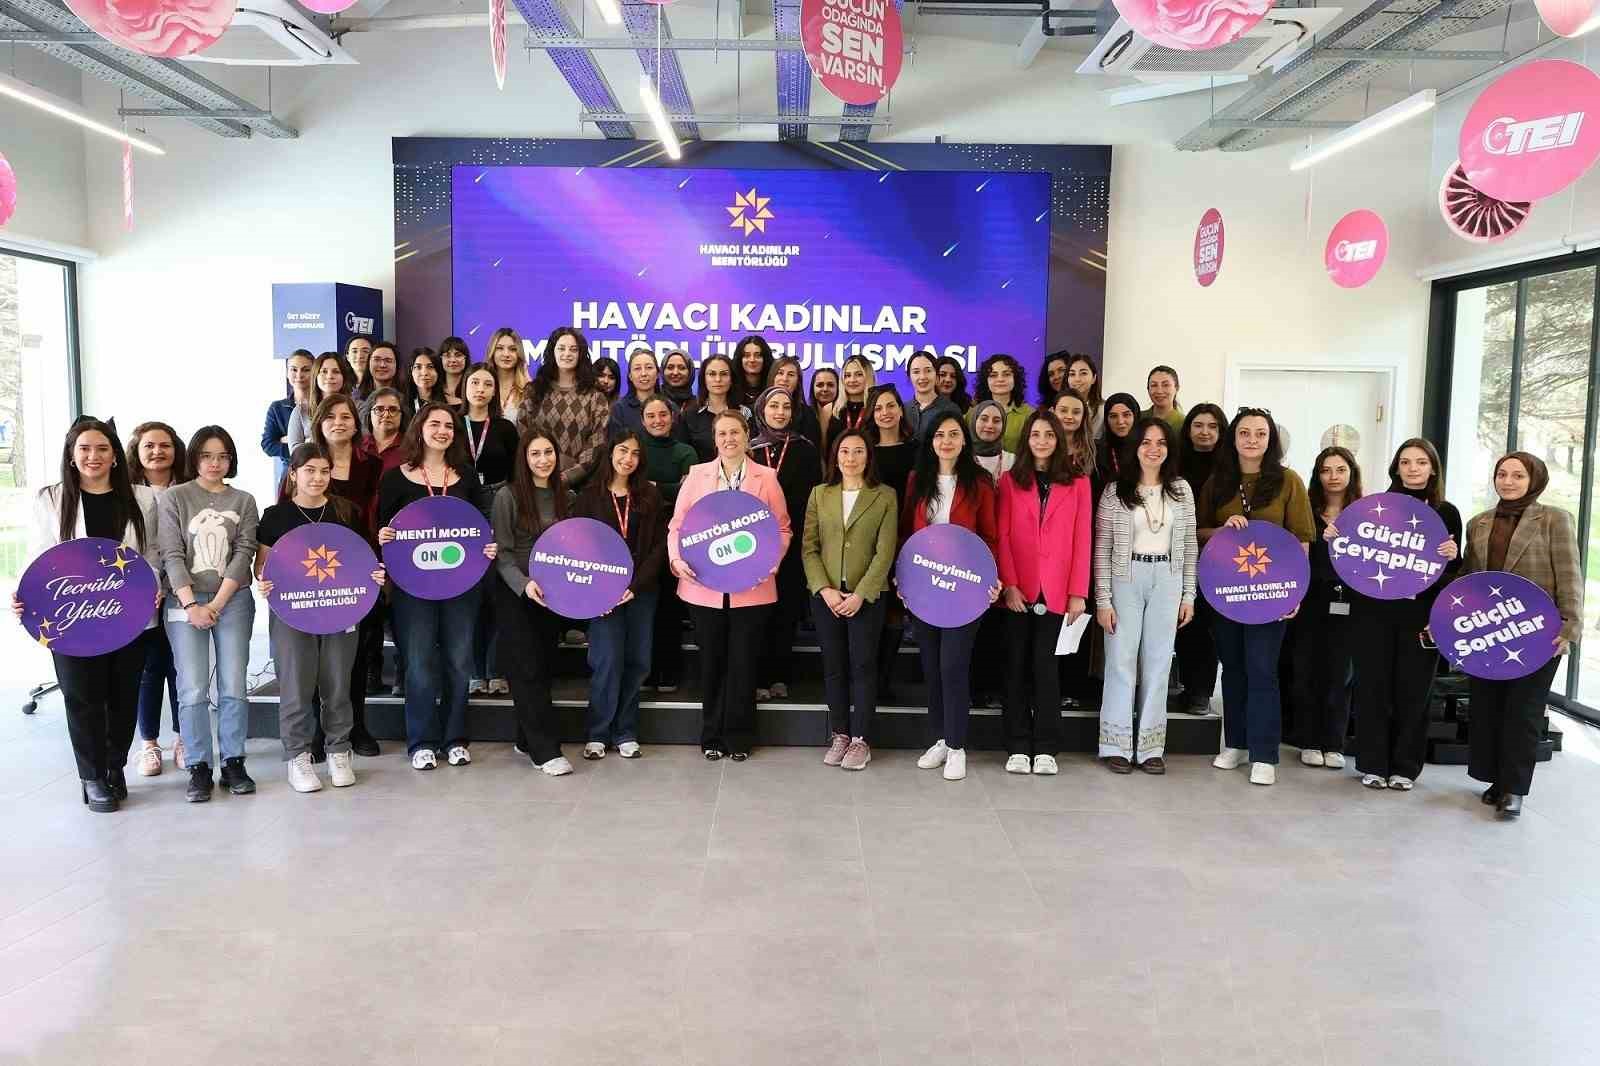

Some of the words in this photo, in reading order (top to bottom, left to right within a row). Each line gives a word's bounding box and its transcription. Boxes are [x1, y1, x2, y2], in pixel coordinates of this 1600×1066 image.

[822, 6, 884, 36] ODAĞINDA
[821, 23, 884, 65] SEN
[821, 53, 883, 87] VARSIN
[1503, 111, 1585, 155] TEI
[699, 244, 739, 255] HAVACI
[743, 245, 800, 256] KADINLAR
[572, 302, 718, 331] HAVACI
[730, 303, 927, 333] KADINLAR
[439, 527, 481, 538] MODE:
[681, 522, 731, 548] MENTÖR
[730, 509, 770, 530] MODE:
[1357, 521, 1426, 551] Güçlü
[421, 550, 438, 562] ON
[534, 551, 628, 575] Motivasyonum
[715, 543, 733, 558] ON
[1332, 536, 1442, 575] Cevaplar
[566, 571, 593, 585] Var!
[912, 553, 982, 583] Deneyimim
[930, 574, 957, 592] Var!
[46, 573, 126, 601] Tecrübe
[280, 590, 316, 601] HAVACI
[318, 586, 367, 598] KADINLAR
[1215, 584, 1248, 595] HAVACI
[1249, 581, 1297, 592] KADINLAR
[55, 599, 124, 631] Yüklü
[1453, 597, 1526, 633] Güçlü
[1454, 615, 1545, 657] Sorular
